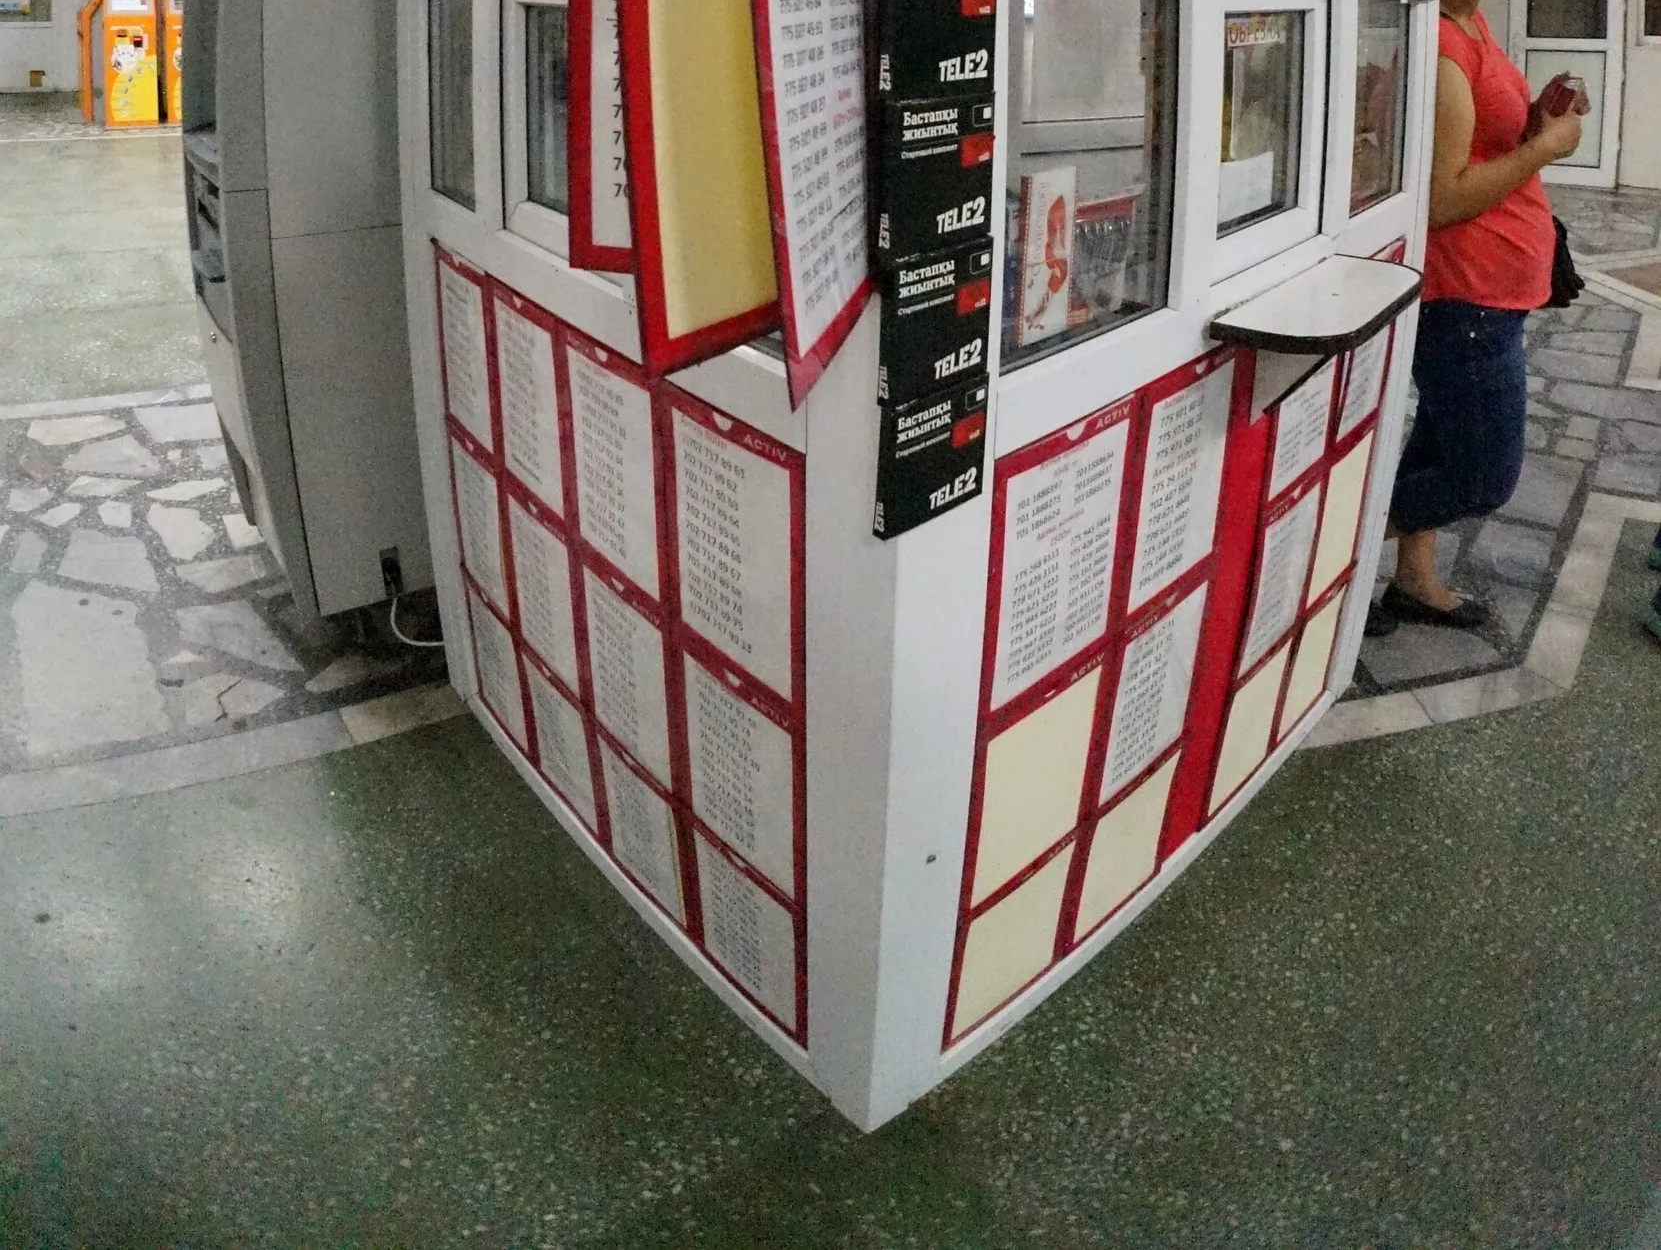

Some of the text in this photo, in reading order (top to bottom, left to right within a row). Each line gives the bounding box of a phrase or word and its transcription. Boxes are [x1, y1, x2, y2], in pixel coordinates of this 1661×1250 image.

[938, 49, 989, 82] TELE2
[936, 195, 986, 234] TELE2
[934, 337, 982, 380] TELE2
[1095, 403, 1131, 430] ACTIV
[744, 433, 788, 463] ACTIV
[929, 466, 977, 510] TELE2
